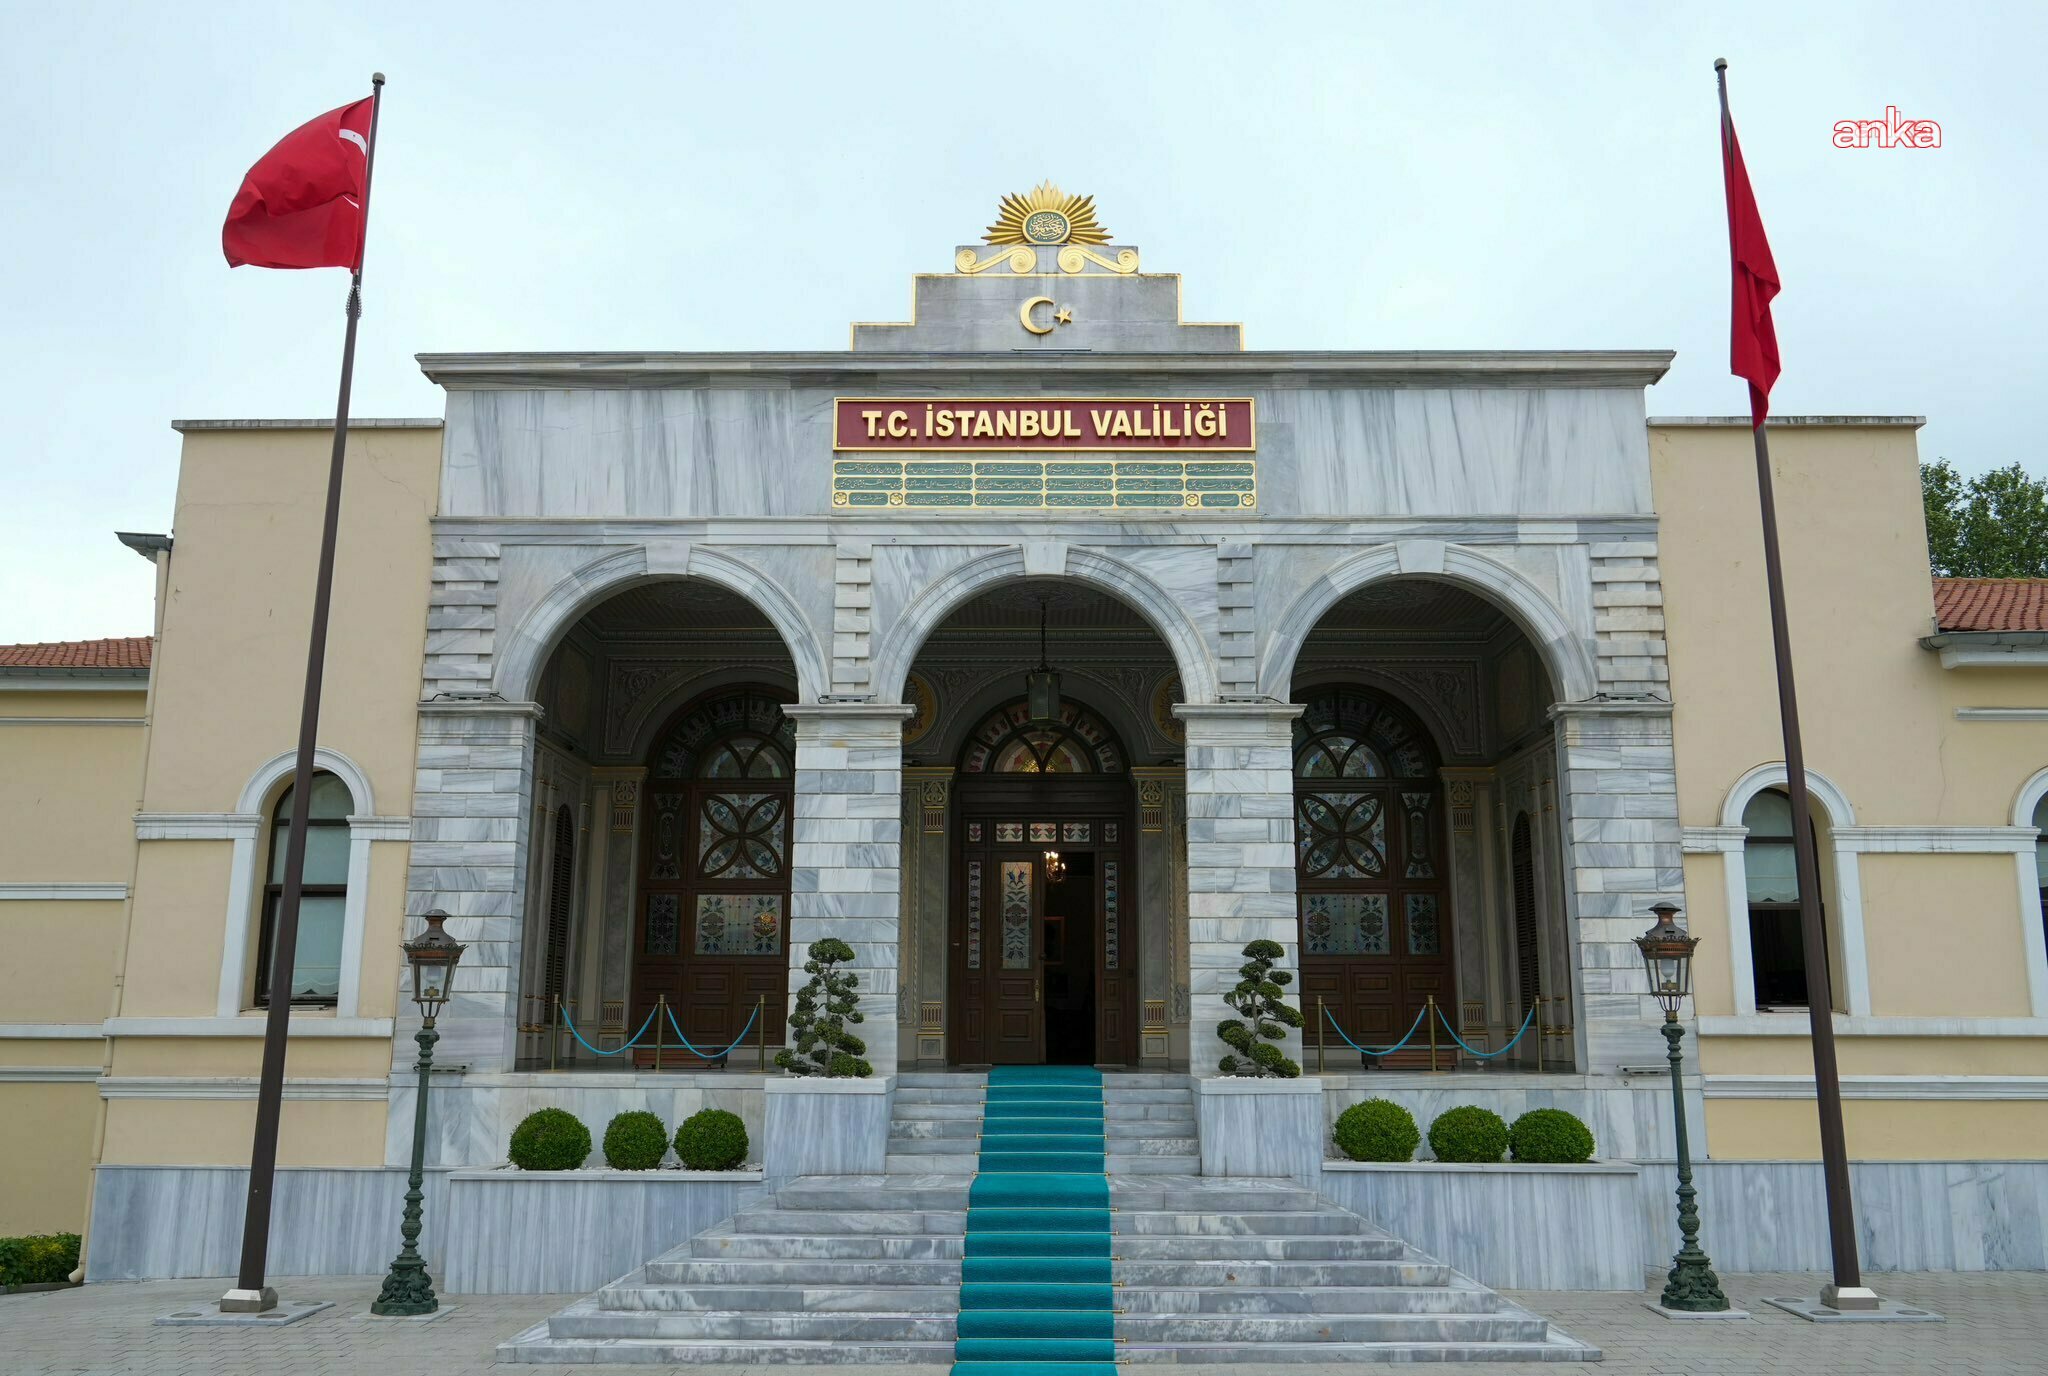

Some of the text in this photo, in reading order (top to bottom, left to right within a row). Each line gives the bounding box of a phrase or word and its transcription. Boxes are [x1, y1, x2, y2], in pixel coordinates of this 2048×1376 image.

[862, 403, 1227, 438] T.C. İSTANBUL VALİLİĞİ
